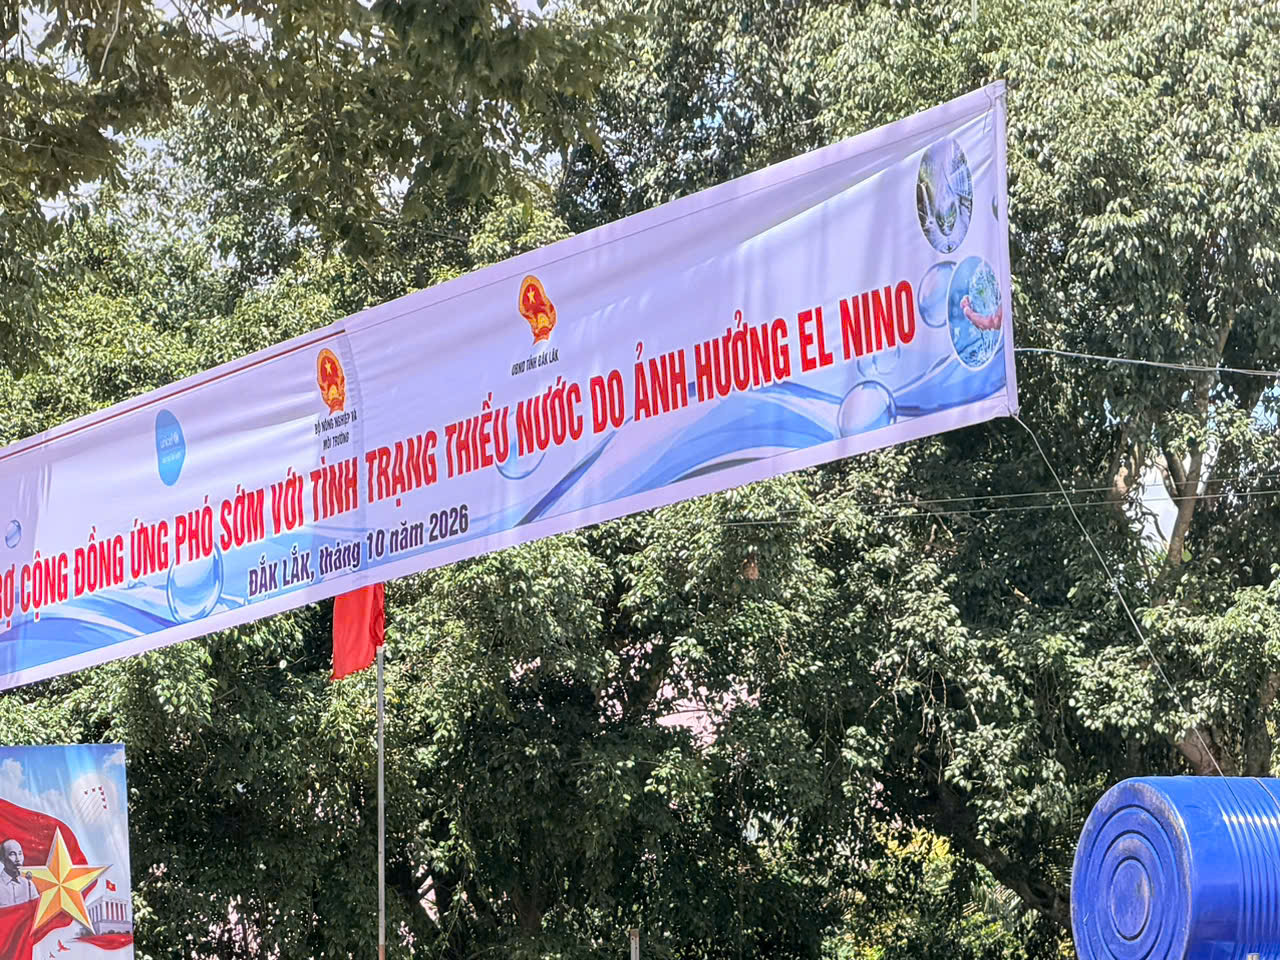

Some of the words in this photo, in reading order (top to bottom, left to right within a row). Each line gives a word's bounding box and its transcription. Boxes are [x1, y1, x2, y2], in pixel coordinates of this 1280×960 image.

[20, 550, 68, 620] CỘNG
[73, 526, 124, 597] ĐỒNG
[130, 517, 169, 579] ỨNG
[175, 494, 213, 566] PHÓ
[220, 484, 265, 552] SỚM
[270, 467, 304, 535] VỚI
[310, 456, 358, 522] TÌNH
[365, 430, 437, 507] TRẠNG
[444, 392, 509, 479] THIẾU
[515, 376, 583, 457] NƯỚC
[590, 369, 625, 434] DO
[634, 341, 688, 422] ẢNH
[694, 309, 791, 402] HƯỞNG
[797, 306, 833, 372] EL
[839, 280, 916, 360] NINO
[249, 555, 278, 597] ĐẮK
[282, 545, 314, 587] LẮK,
[320, 540, 361, 576] tháng
[366, 529, 385, 560] 10
[389, 520, 424, 553] năm
[429, 503, 469, 542] 2026
